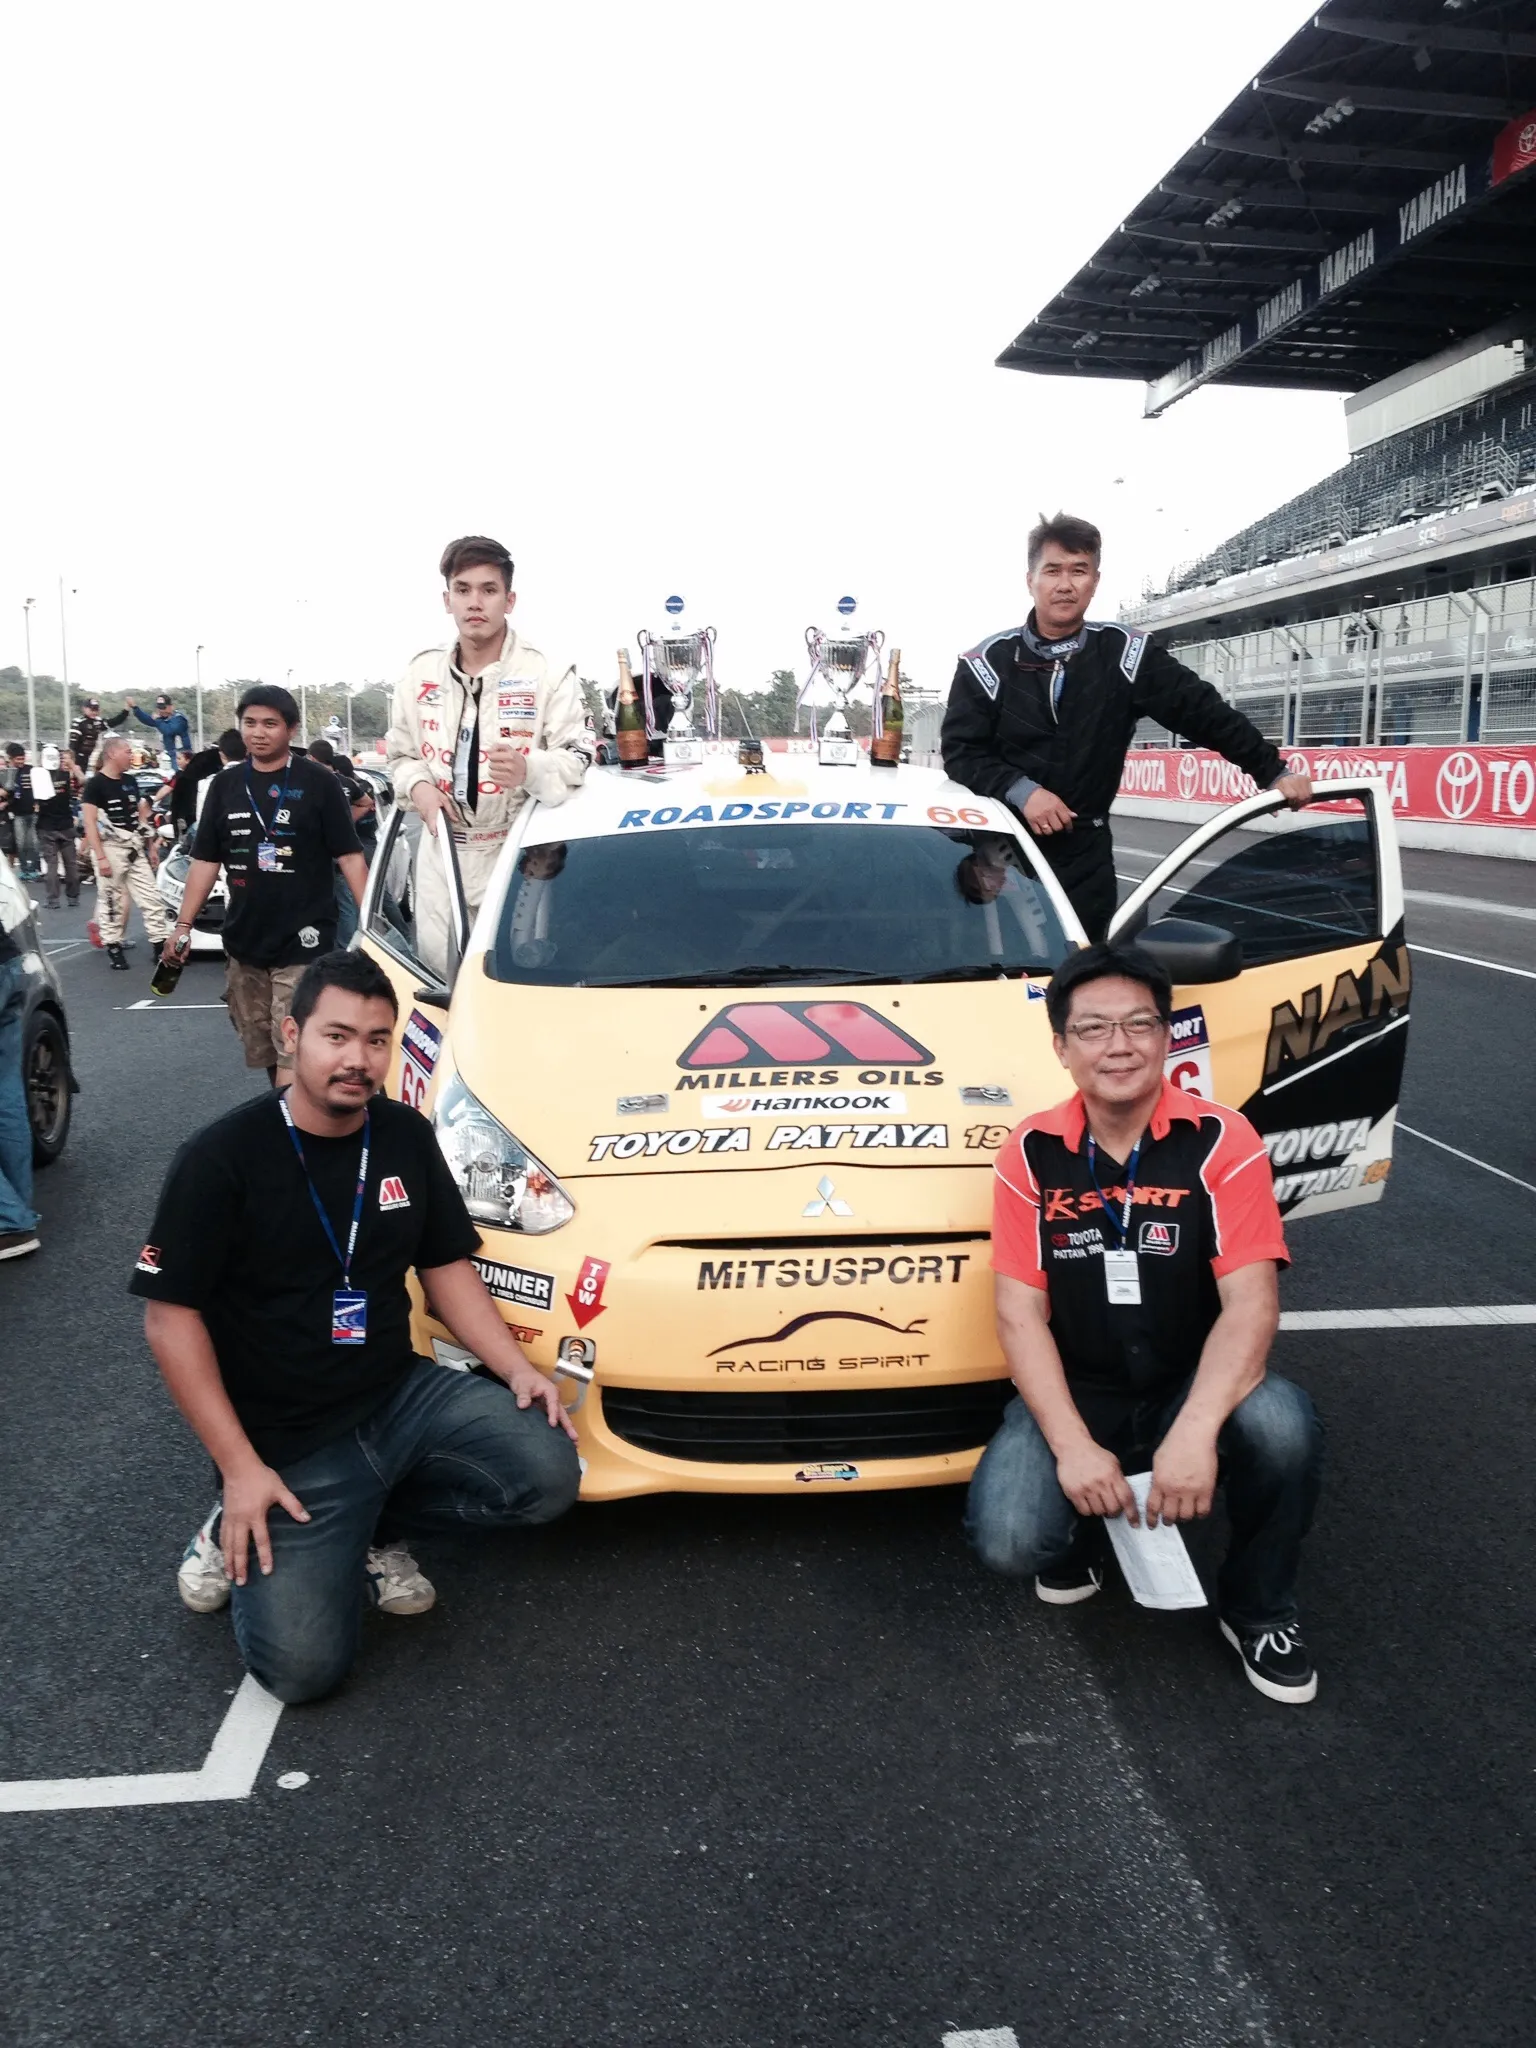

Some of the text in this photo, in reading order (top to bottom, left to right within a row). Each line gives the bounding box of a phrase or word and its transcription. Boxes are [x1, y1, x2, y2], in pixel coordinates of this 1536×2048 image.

[1399, 163, 1467, 245] YAMAHA
[1319, 228, 1375, 296] YAMAHA
[1257, 279, 1302, 340] YAMAHA
[1488, 760, 1536, 816] TO
[618, 802, 988, 829] ROADSPORT 66
[1264, 945, 1411, 1077] NAN
[675, 1070, 945, 1090] MILLERS OILS
[587, 1127, 750, 1162] TOYOTA
[765, 1124, 949, 1150] PATTAYA
[1262, 1117, 1372, 1167] TOYOTA
[1272, 1164, 1358, 1203] ATTAYA
[1067, 1227, 1104, 1246] TOYOTA
[577, 1262, 603, 1307] TOW
